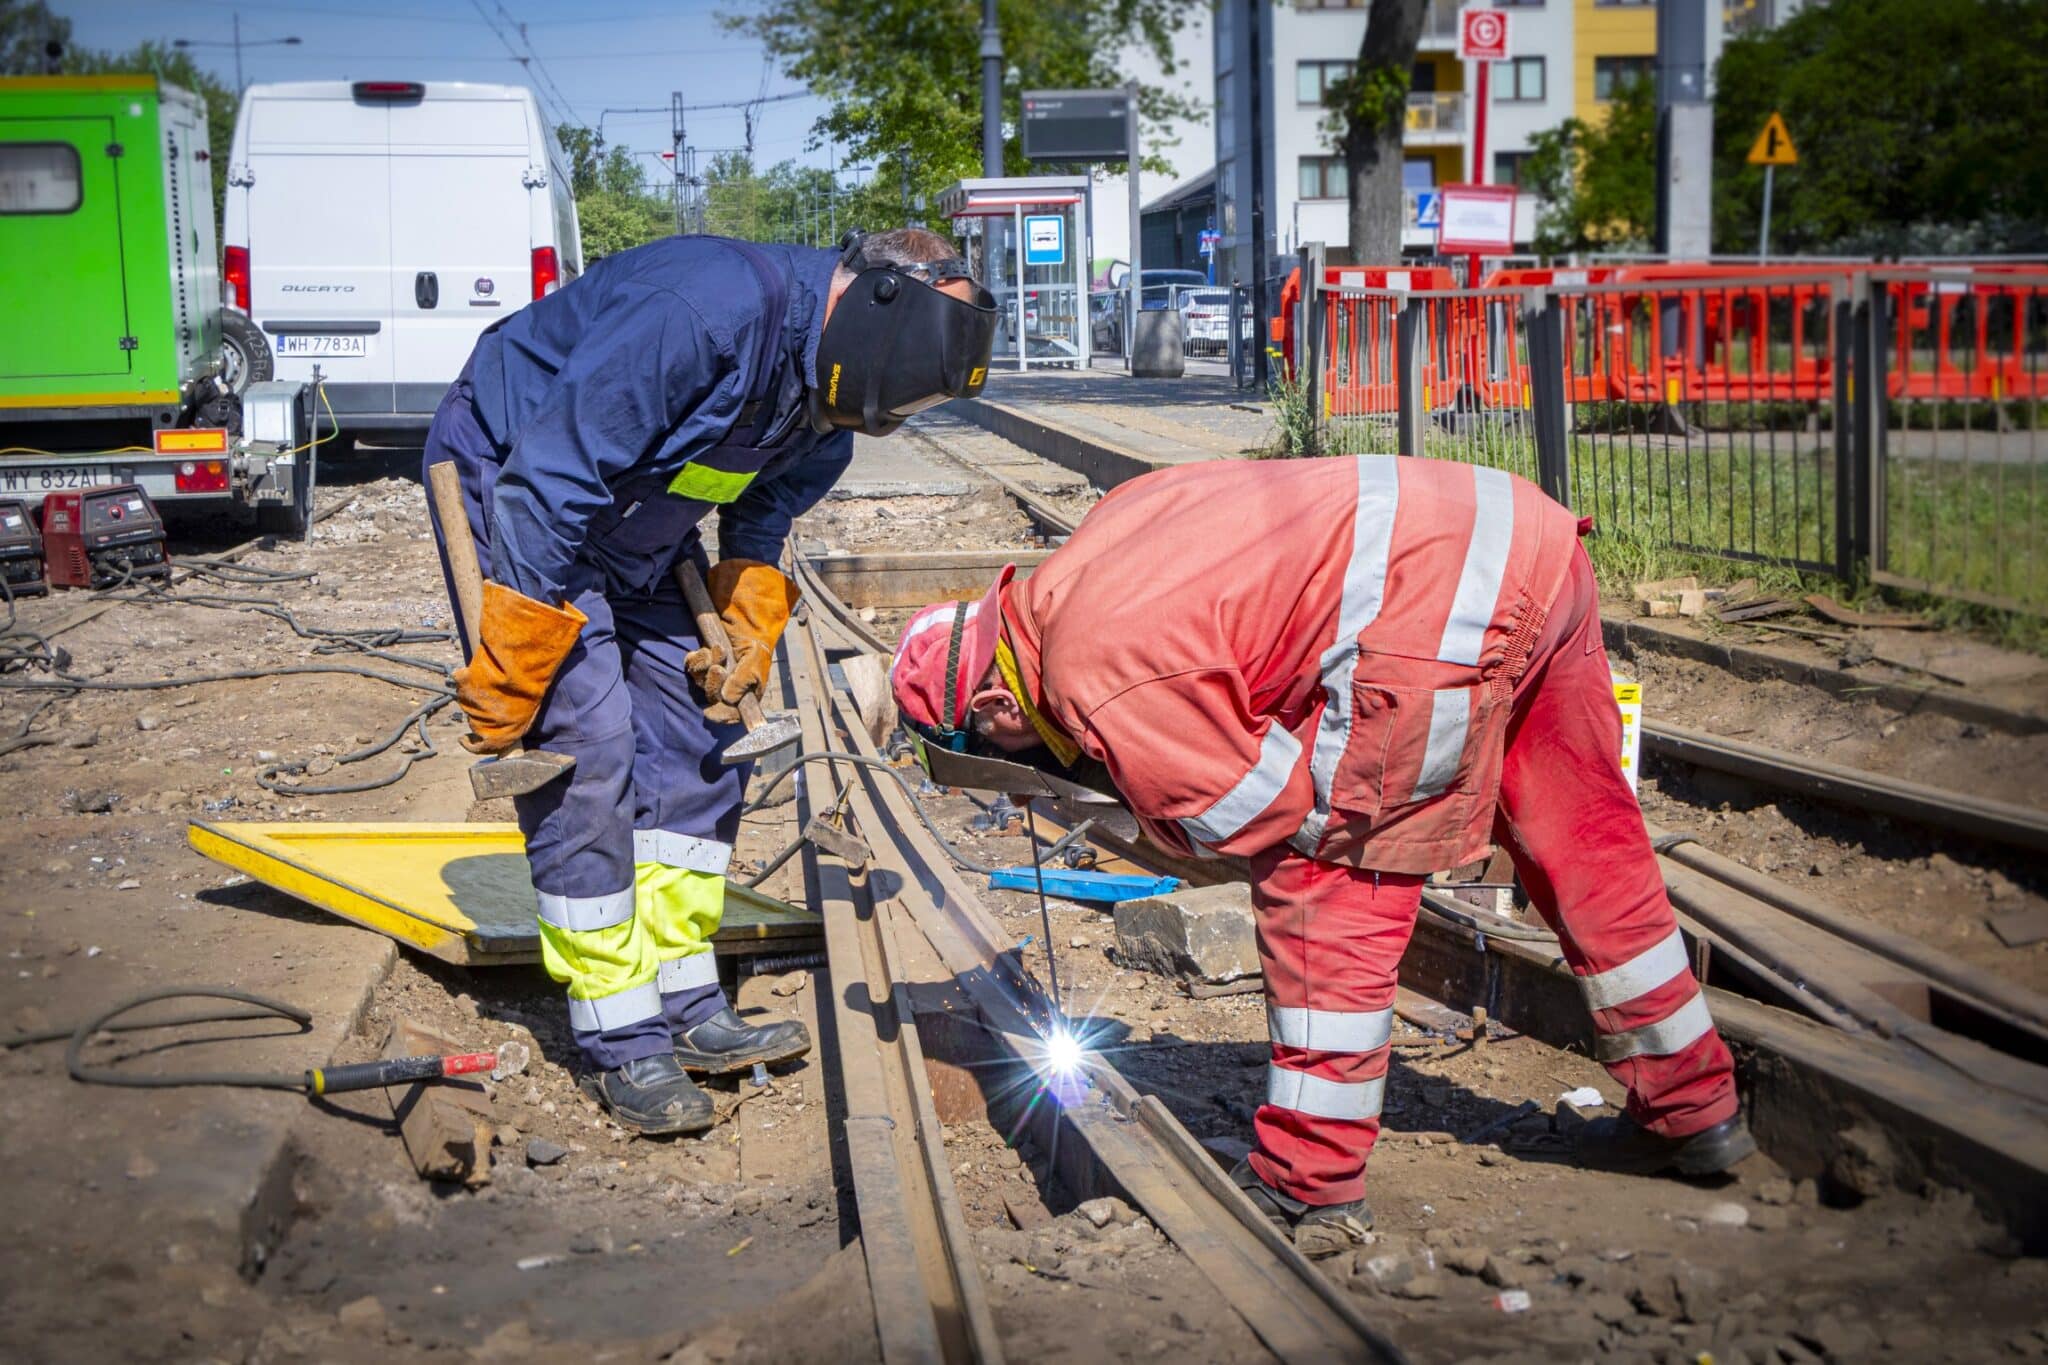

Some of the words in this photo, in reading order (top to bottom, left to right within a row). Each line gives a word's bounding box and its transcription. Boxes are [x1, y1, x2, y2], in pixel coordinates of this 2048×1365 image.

[288, 337, 308, 352] WH
[313, 337, 361, 352] 7783A
[828, 363, 841, 407] SAVAGE
[4, 470, 31, 490] WY
